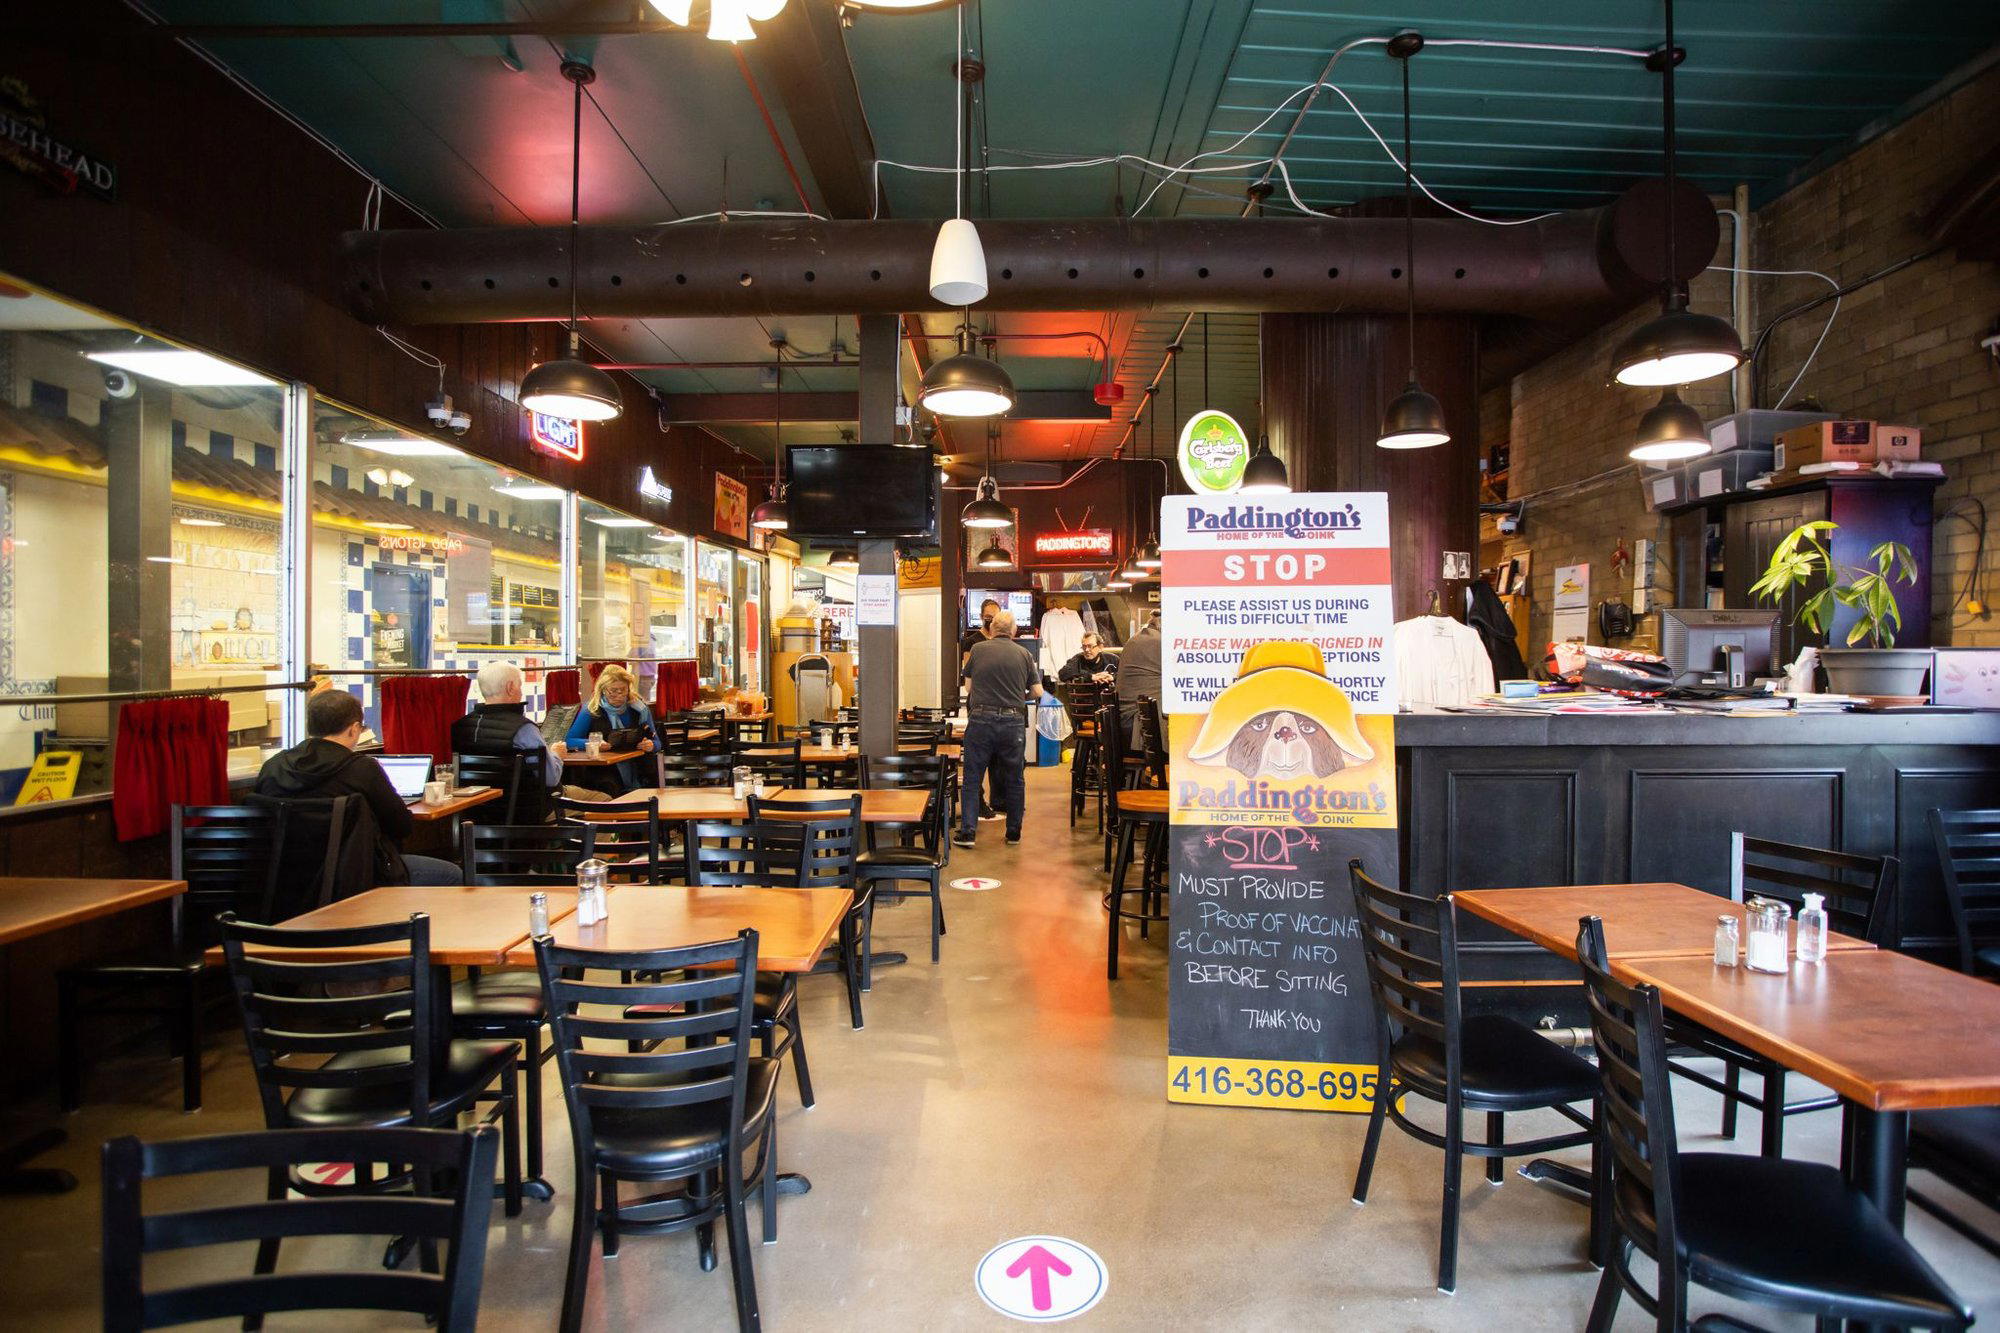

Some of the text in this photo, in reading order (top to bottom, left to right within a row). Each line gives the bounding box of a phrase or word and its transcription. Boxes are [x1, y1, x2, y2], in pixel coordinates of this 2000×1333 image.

[1187, 503, 1361, 539] Paddington's
[1216, 532, 1249, 541] HOME
[1307, 531, 1336, 540] OINK
[1223, 554, 1326, 581] STOP
[1184, 599, 1369, 611] PLEASE ASSIST US DURING
[1206, 613, 1348, 625] THIS DIFFICULT TIME
[1173, 638, 1227, 650] PLEASE
[1230, 638, 1265, 650] WAI
[1312, 637, 1364, 649] SIGNED
[1367, 637, 1383, 649] IN
[1173, 677, 1194, 688] WE
[1197, 677, 1228, 688] WILL
[1327, 676, 1386, 688] HORTLY
[1181, 691, 1221, 702] THAN
[1177, 780, 1388, 823] Paddington's
[1210, 813, 1248, 822] HOME
[1268, 814, 1289, 822] THE
[1322, 815, 1354, 824] OINK
[1178, 873, 1325, 900] MUST PROVIDE
[1198, 902, 1259, 929] PROOF
[1262, 912, 1287, 932] OF
[1196, 932, 1282, 958] CONTACT
[1293, 944, 1338, 964] INFO
[1185, 962, 1348, 996] BEFORE SITTING
[1172, 1065, 1401, 1102] 416-368-695
